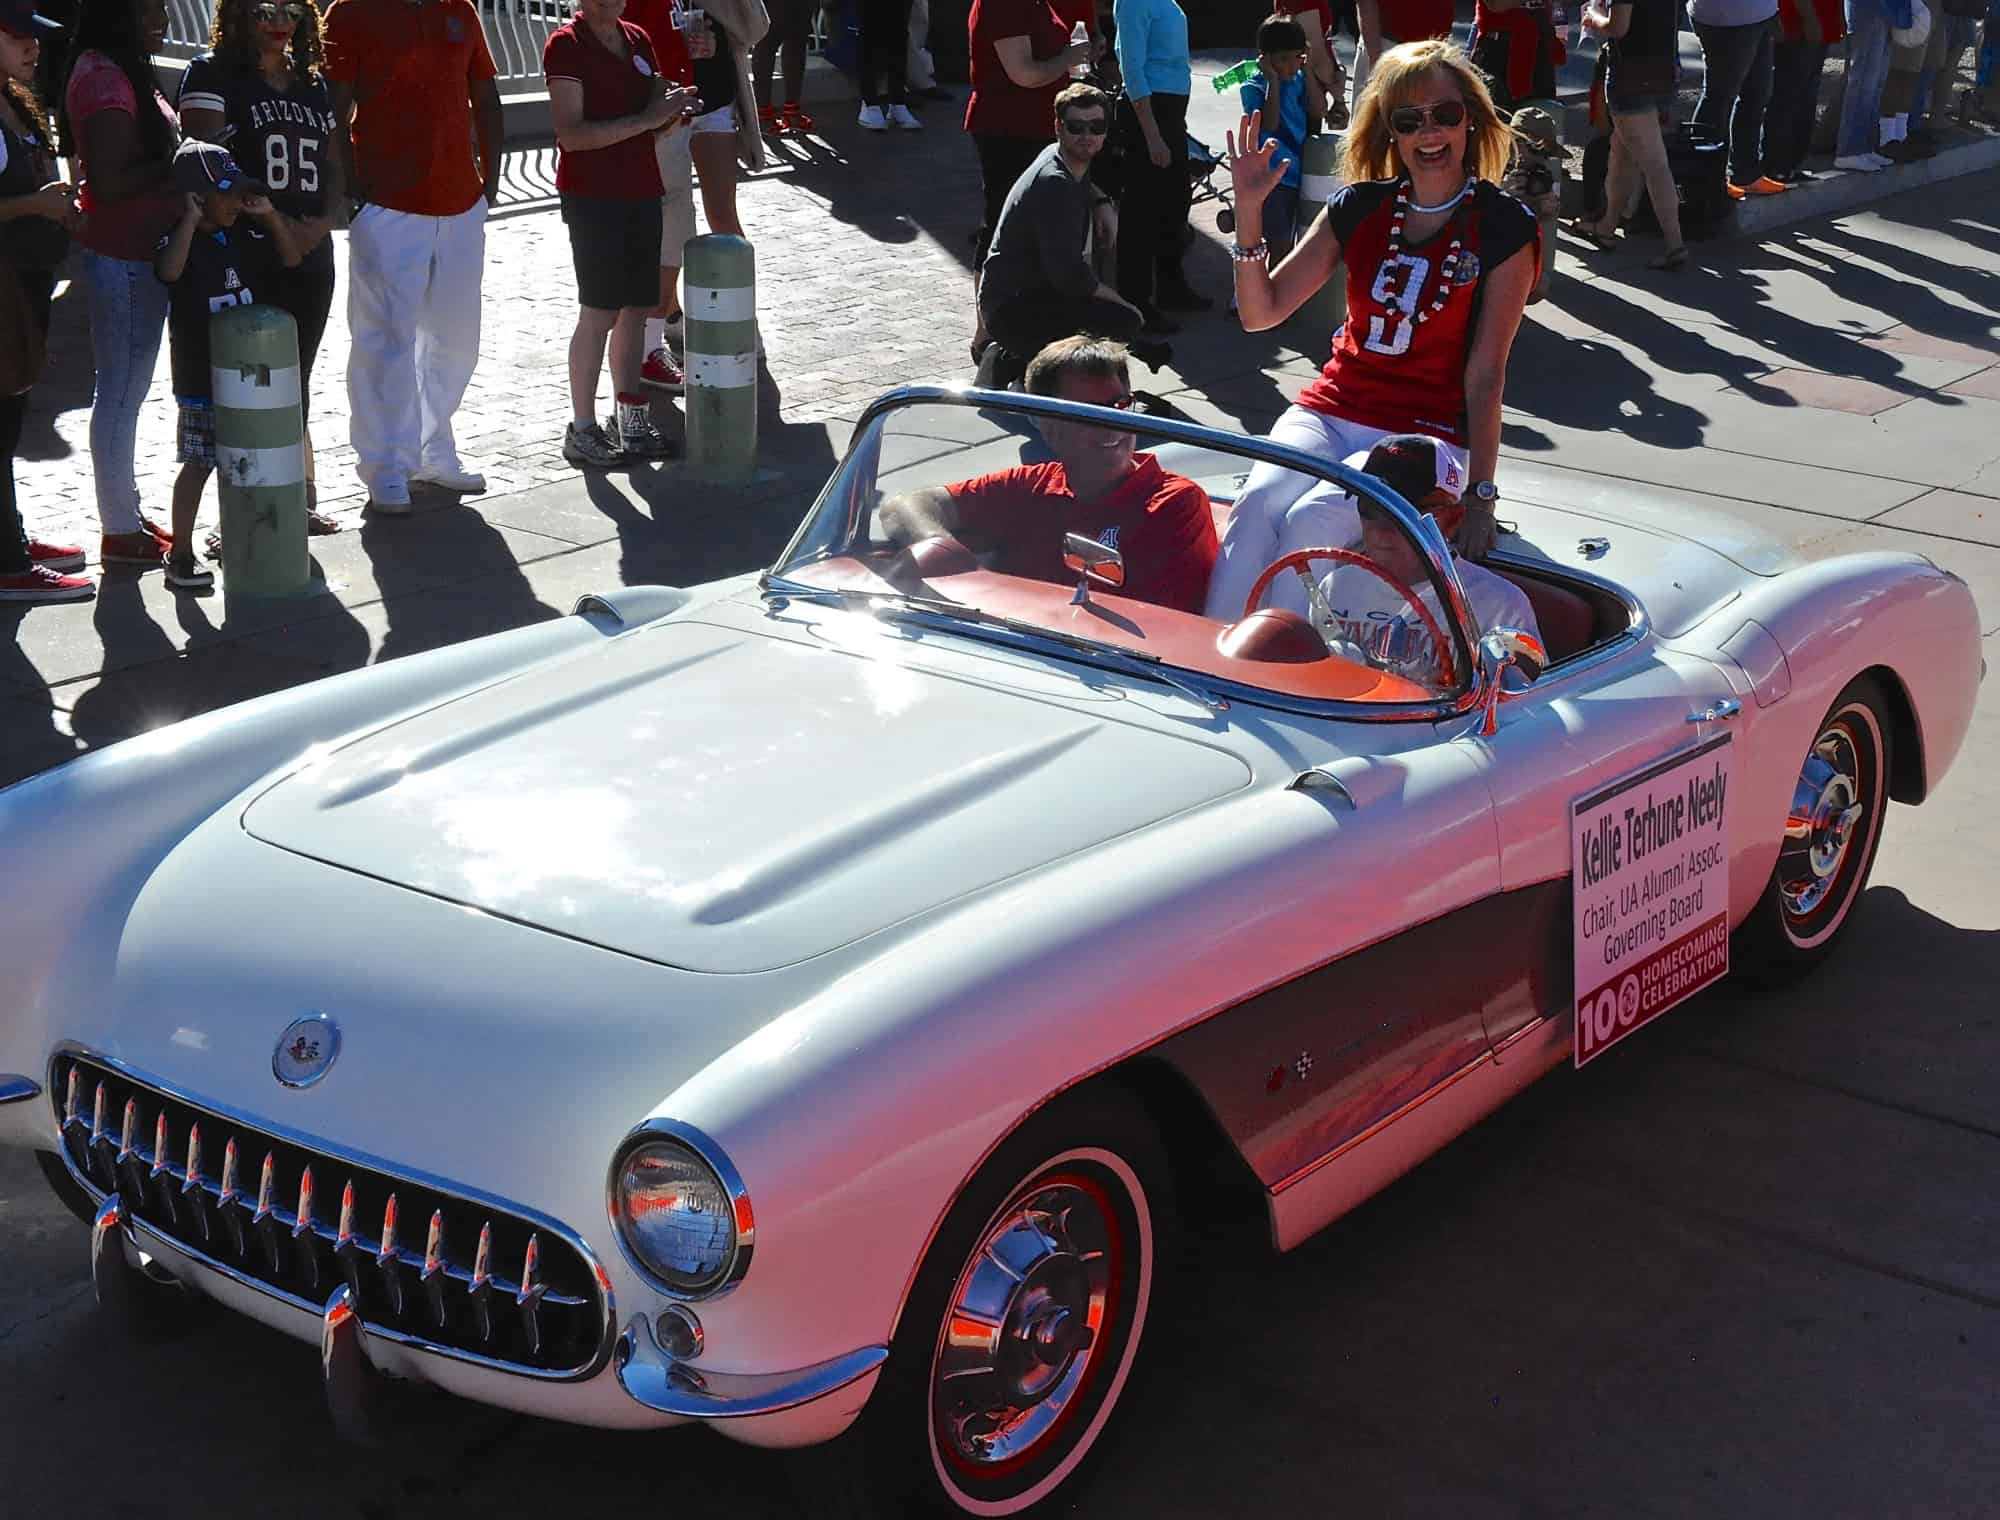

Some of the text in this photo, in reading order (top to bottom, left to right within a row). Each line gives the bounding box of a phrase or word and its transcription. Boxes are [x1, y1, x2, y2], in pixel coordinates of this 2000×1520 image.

[265, 134, 319, 192] 85
[1444, 462, 1460, 489] A
[1582, 761, 1727, 889] Kellie Terhune Neely
[1583, 842, 1723, 939] Chair, UA Alumni Assoc.
[1604, 880, 1704, 965] Governing Board
[1642, 922, 1726, 988] HOMECOMING
[1642, 943, 1726, 1010] CELEBRATION
